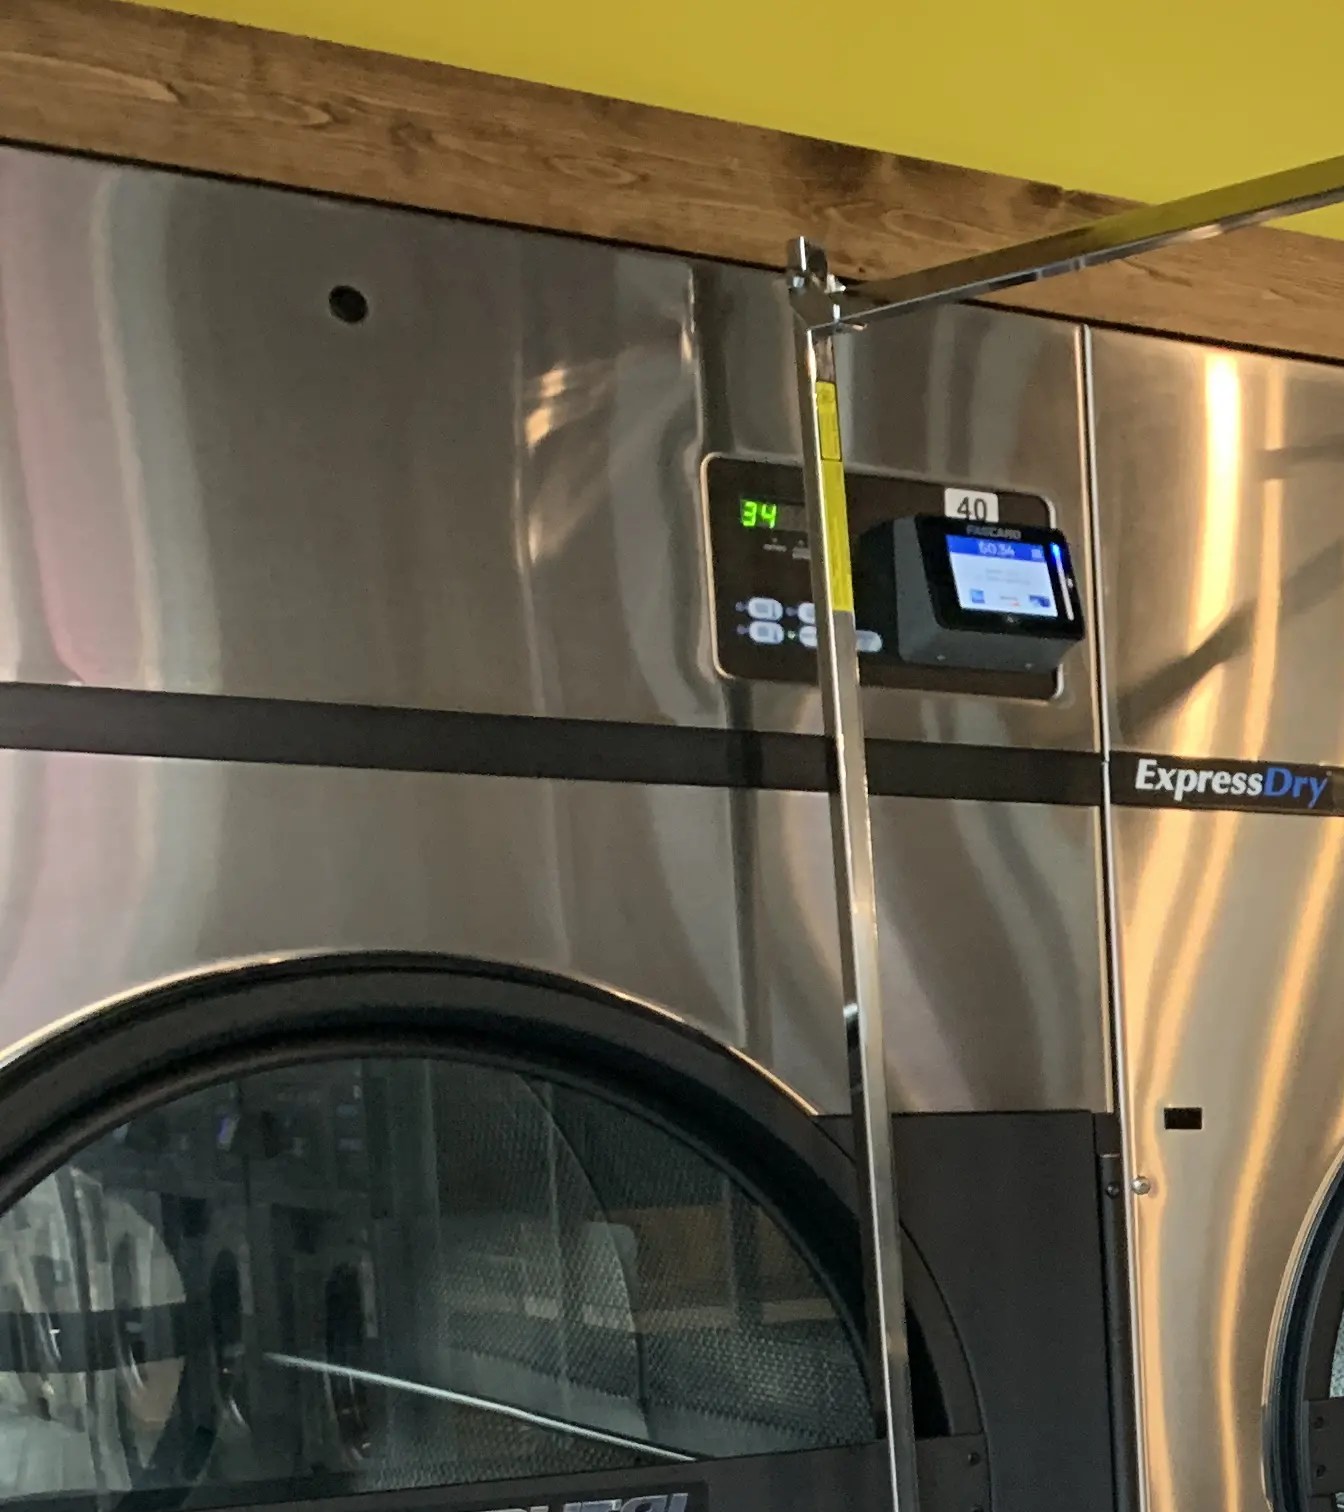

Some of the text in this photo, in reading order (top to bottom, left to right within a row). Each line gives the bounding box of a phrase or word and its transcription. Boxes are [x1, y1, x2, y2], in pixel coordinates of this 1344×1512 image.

[742, 501, 777, 529] 34
[957, 496, 988, 521] 40
[1135, 758, 1328, 809] ExpressDry
